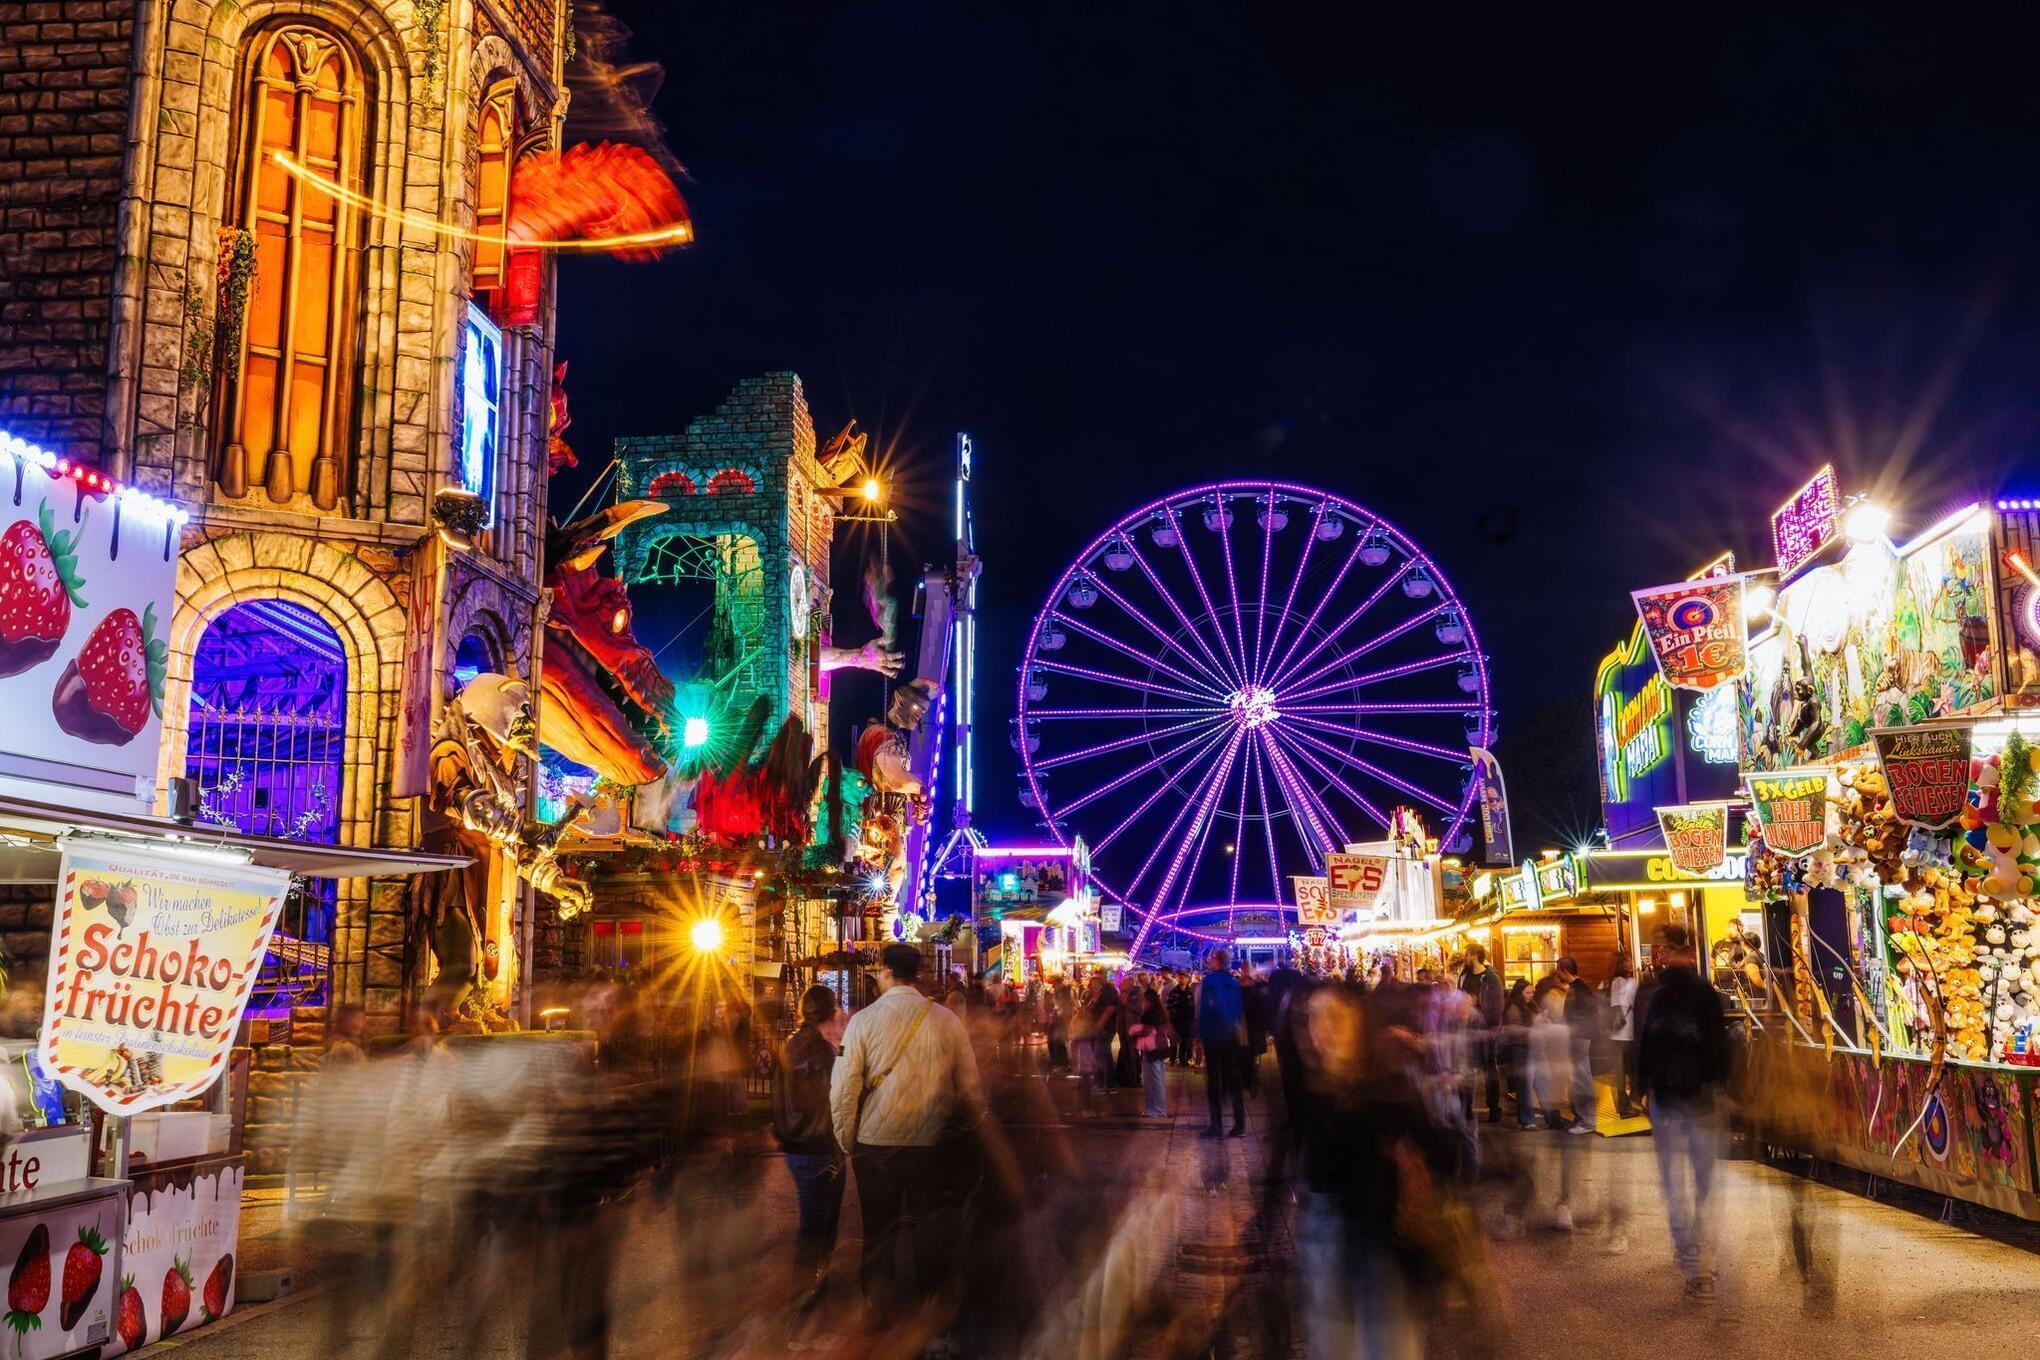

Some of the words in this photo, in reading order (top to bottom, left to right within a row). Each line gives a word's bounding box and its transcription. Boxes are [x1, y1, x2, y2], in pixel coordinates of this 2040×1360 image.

[1660, 633, 1691, 655] Ein
[1692, 623, 1736, 643] Pfeil
[1678, 641, 1729, 672] 1€
[1894, 735, 1920, 744] HIER
[1925, 732, 1953, 743] AUCH
[1706, 748, 1738, 763] MAF
[1783, 776, 1825, 800] GELB
[1887, 759, 1968, 790] BOGEN
[1770, 800, 1812, 822] FREIE
[1893, 783, 1967, 816] SCHIESSEN
[1667, 828, 1723, 848] BOGEN
[1764, 821, 1824, 852] AUSWAHL
[1671, 845, 1724, 868] SCHIESSEN
[142, 882, 169, 908] Wir
[172, 889, 212, 912] machen
[152, 911, 180, 937] Obst
[183, 922, 199, 935] zur
[200, 896, 262, 934] Delikatesse!
[75, 923, 244, 991] Schoko-
[63, 969, 224, 1040] früchte
